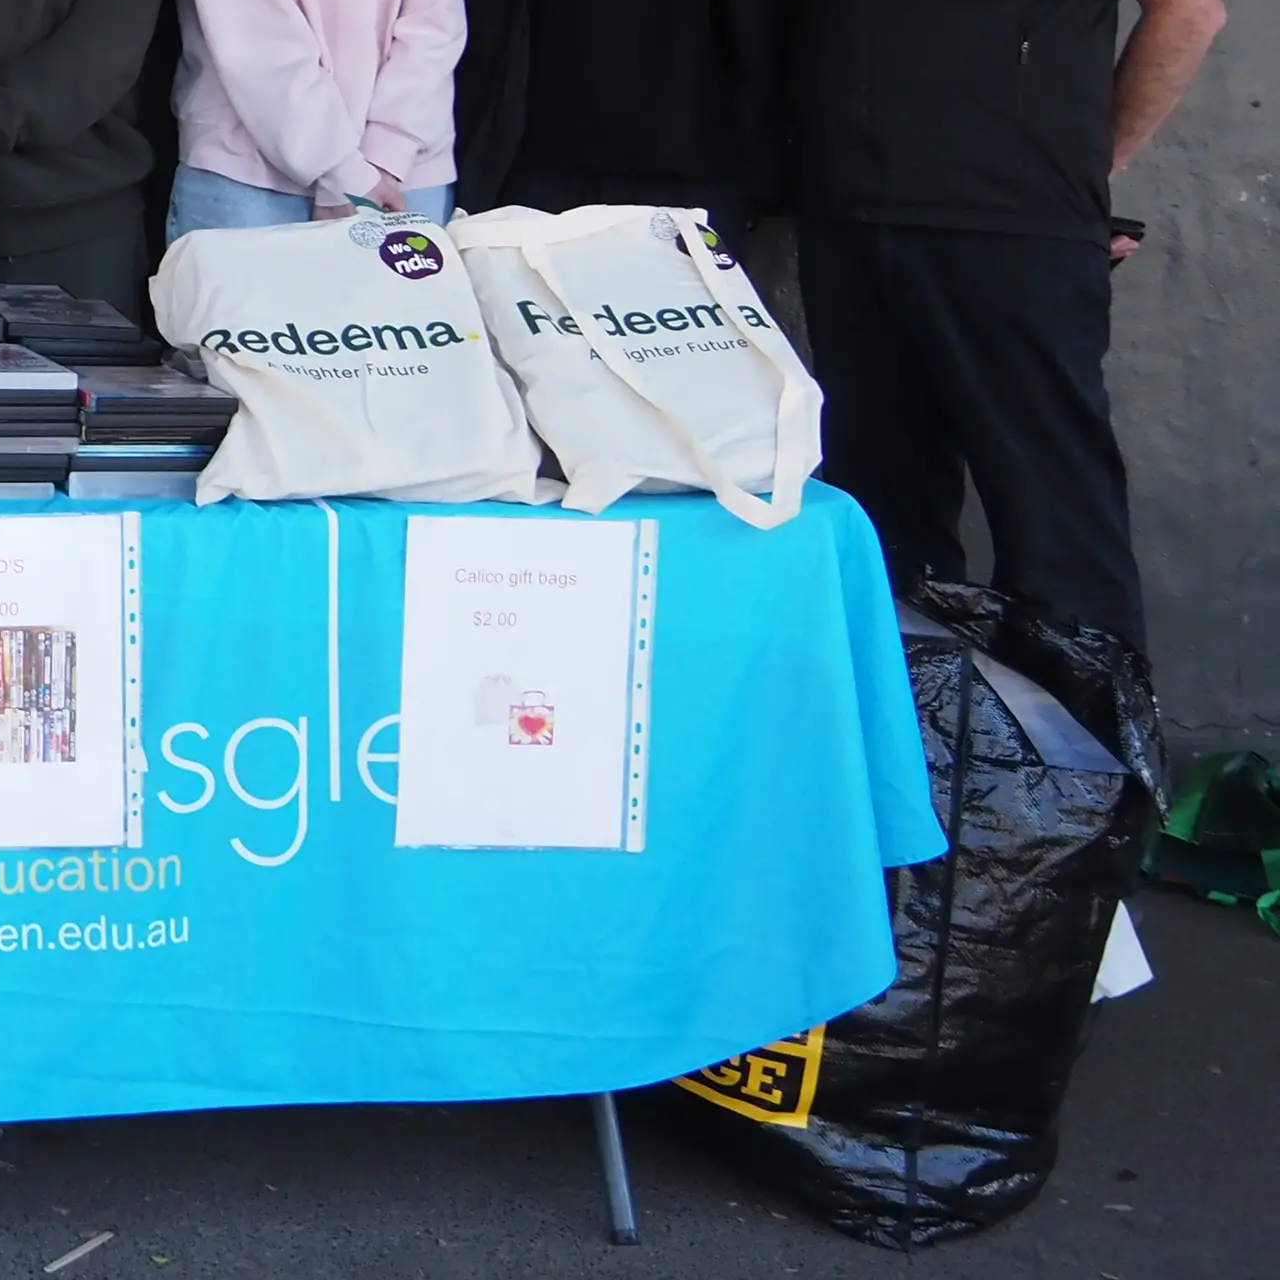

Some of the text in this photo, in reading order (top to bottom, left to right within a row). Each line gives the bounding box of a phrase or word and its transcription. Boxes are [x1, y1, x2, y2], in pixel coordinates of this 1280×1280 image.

[387, 243, 413, 255] We
[394, 253, 439, 274] ndis
[622, 345, 682, 364] ighter
[686, 337, 750, 354] Future
[365, 362, 429, 377] Future
[455, 567, 578, 589] Calico gift bags
